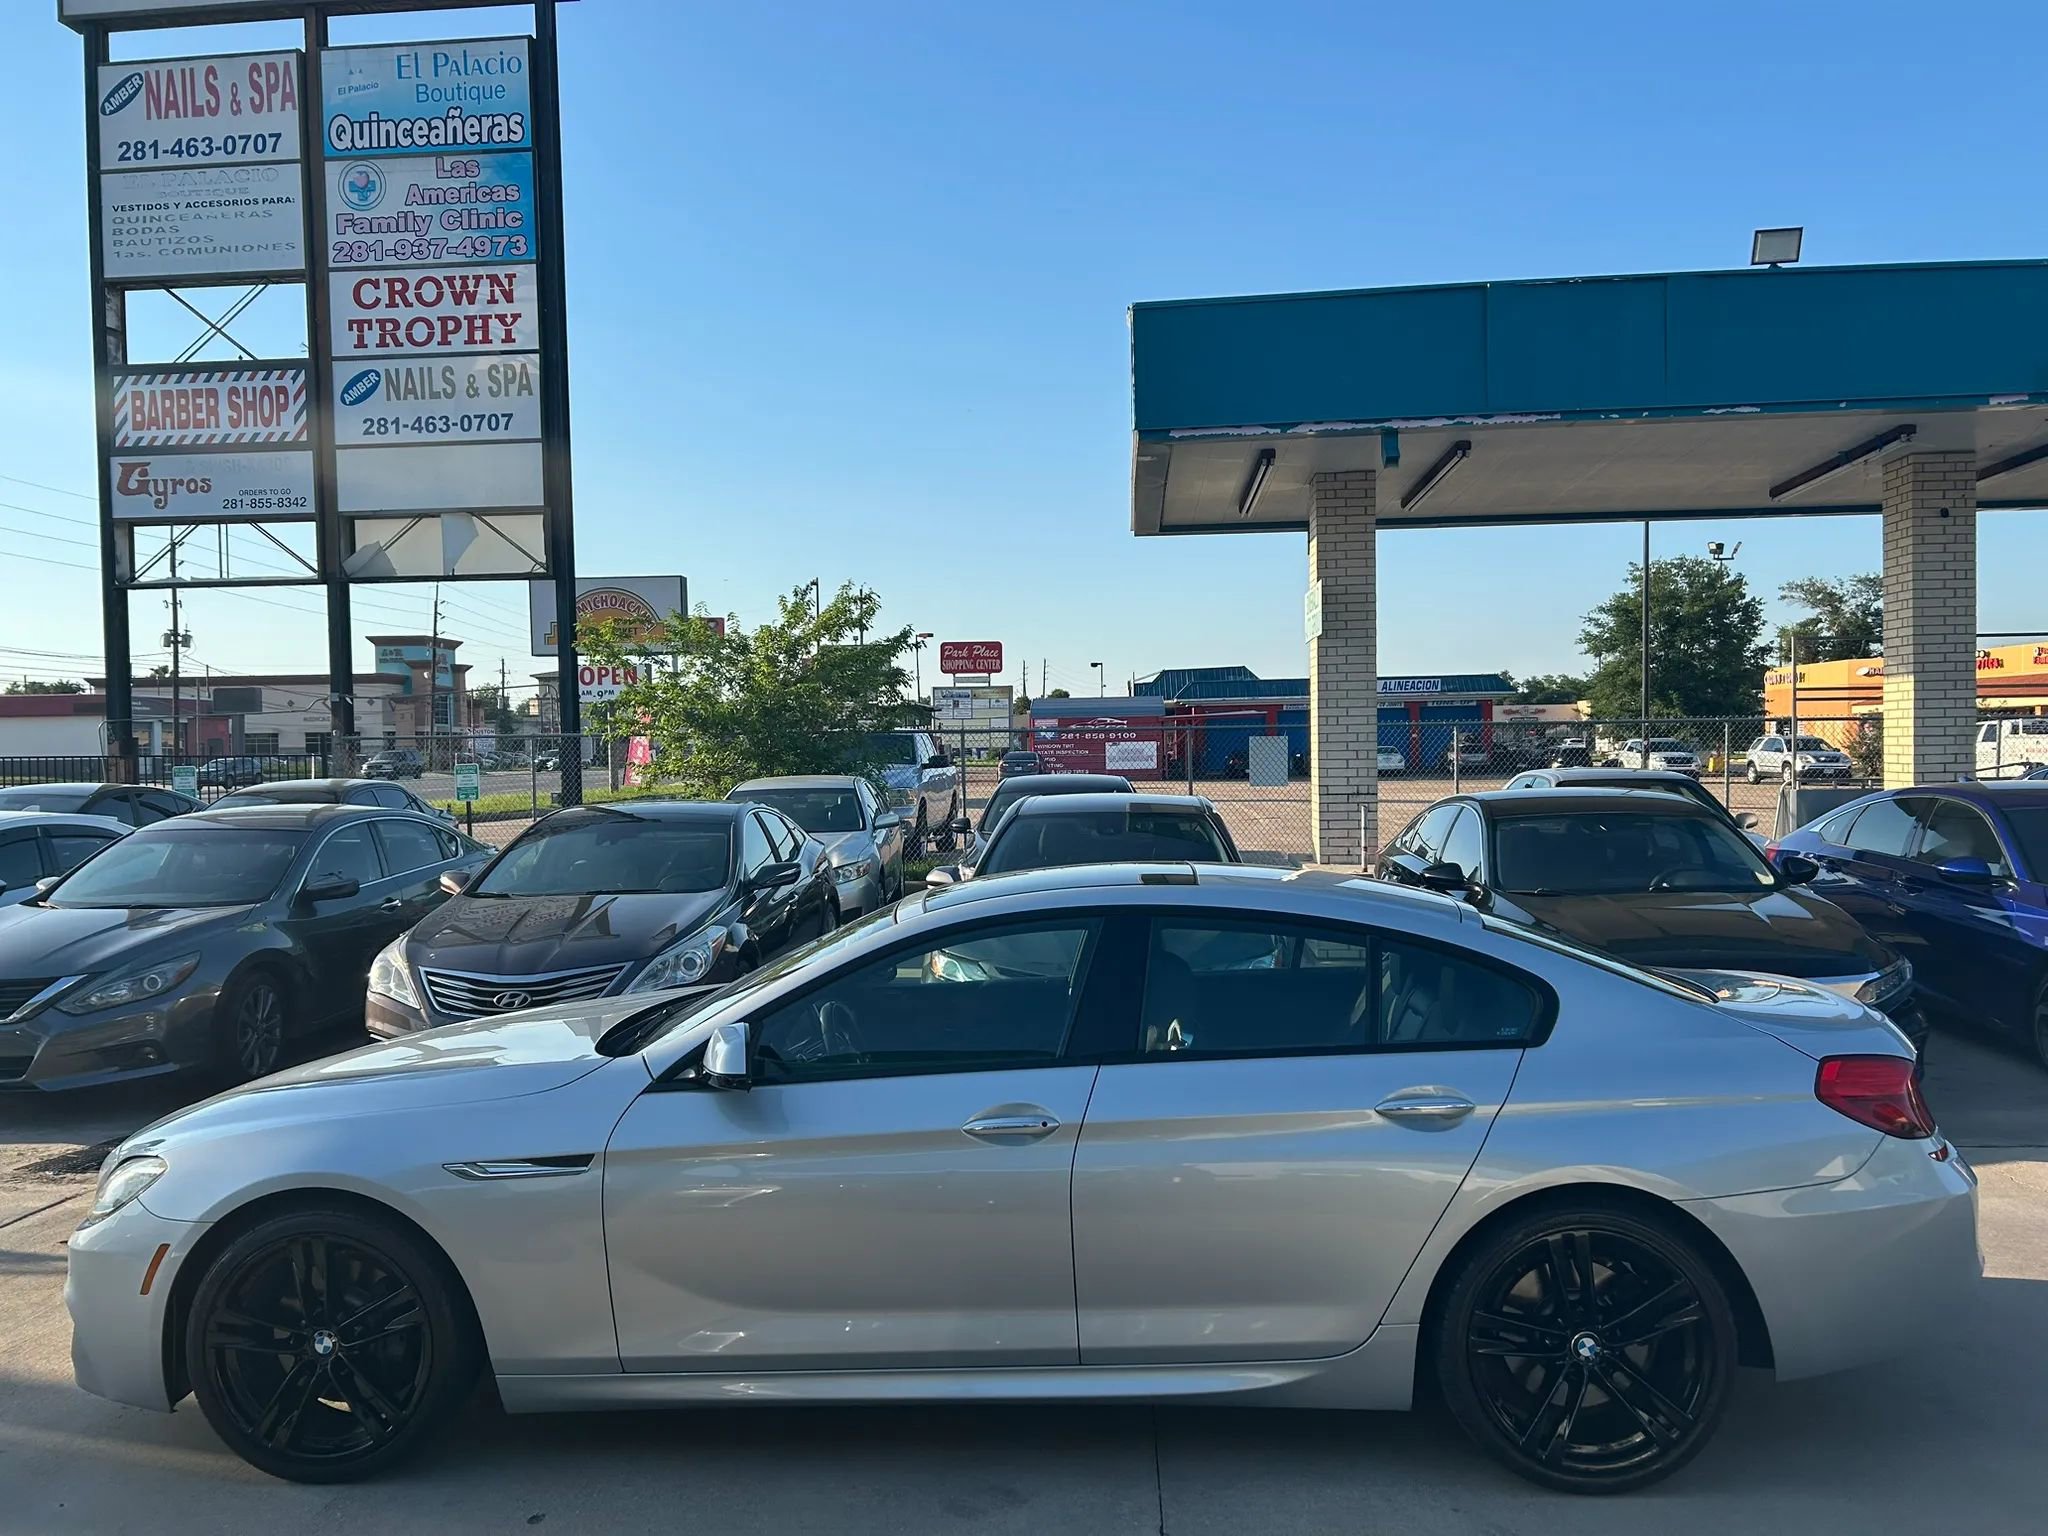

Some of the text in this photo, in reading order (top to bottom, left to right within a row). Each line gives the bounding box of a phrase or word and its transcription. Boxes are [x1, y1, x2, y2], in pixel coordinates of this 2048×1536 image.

[396, 52, 422, 80] El
[103, 74, 144, 115] AMBER
[144, 61, 297, 120] NAILS & SPA
[348, 80, 379, 94] Palacio
[416, 83, 506, 105] Boutique
[329, 106, 525, 151] Quinceañeras
[117, 132, 282, 161] 281-463-0707
[435, 157, 480, 179] Las
[112, 196, 295, 212] VESTIDOS Y ACCESORIOS PARA:
[405, 182, 520, 206] Americas
[112, 225, 180, 236] BODAS
[336, 208, 524, 237] Family Clinic
[112, 235, 214, 248] BAUTIZOS
[158, 242, 296, 256] COMUNIONES
[333, 234, 528, 263] 281-937-4973
[352, 273, 517, 310] CROWN
[348, 312, 522, 349] TROPHY
[343, 371, 380, 405] AMBER
[384, 363, 533, 402] NAILS & SPA
[130, 385, 290, 431] BARBER SHOP
[362, 413, 514, 436] 281-463-0707
[116, 461, 212, 509] Gyros
[222, 496, 307, 509] 281-855-8342
[944, 645, 999, 658] Park Place
[580, 666, 637, 686] OPEN
[942, 659, 1001, 671] SHOPPING CENTER
[1381, 680, 1440, 691] ALINEACION
